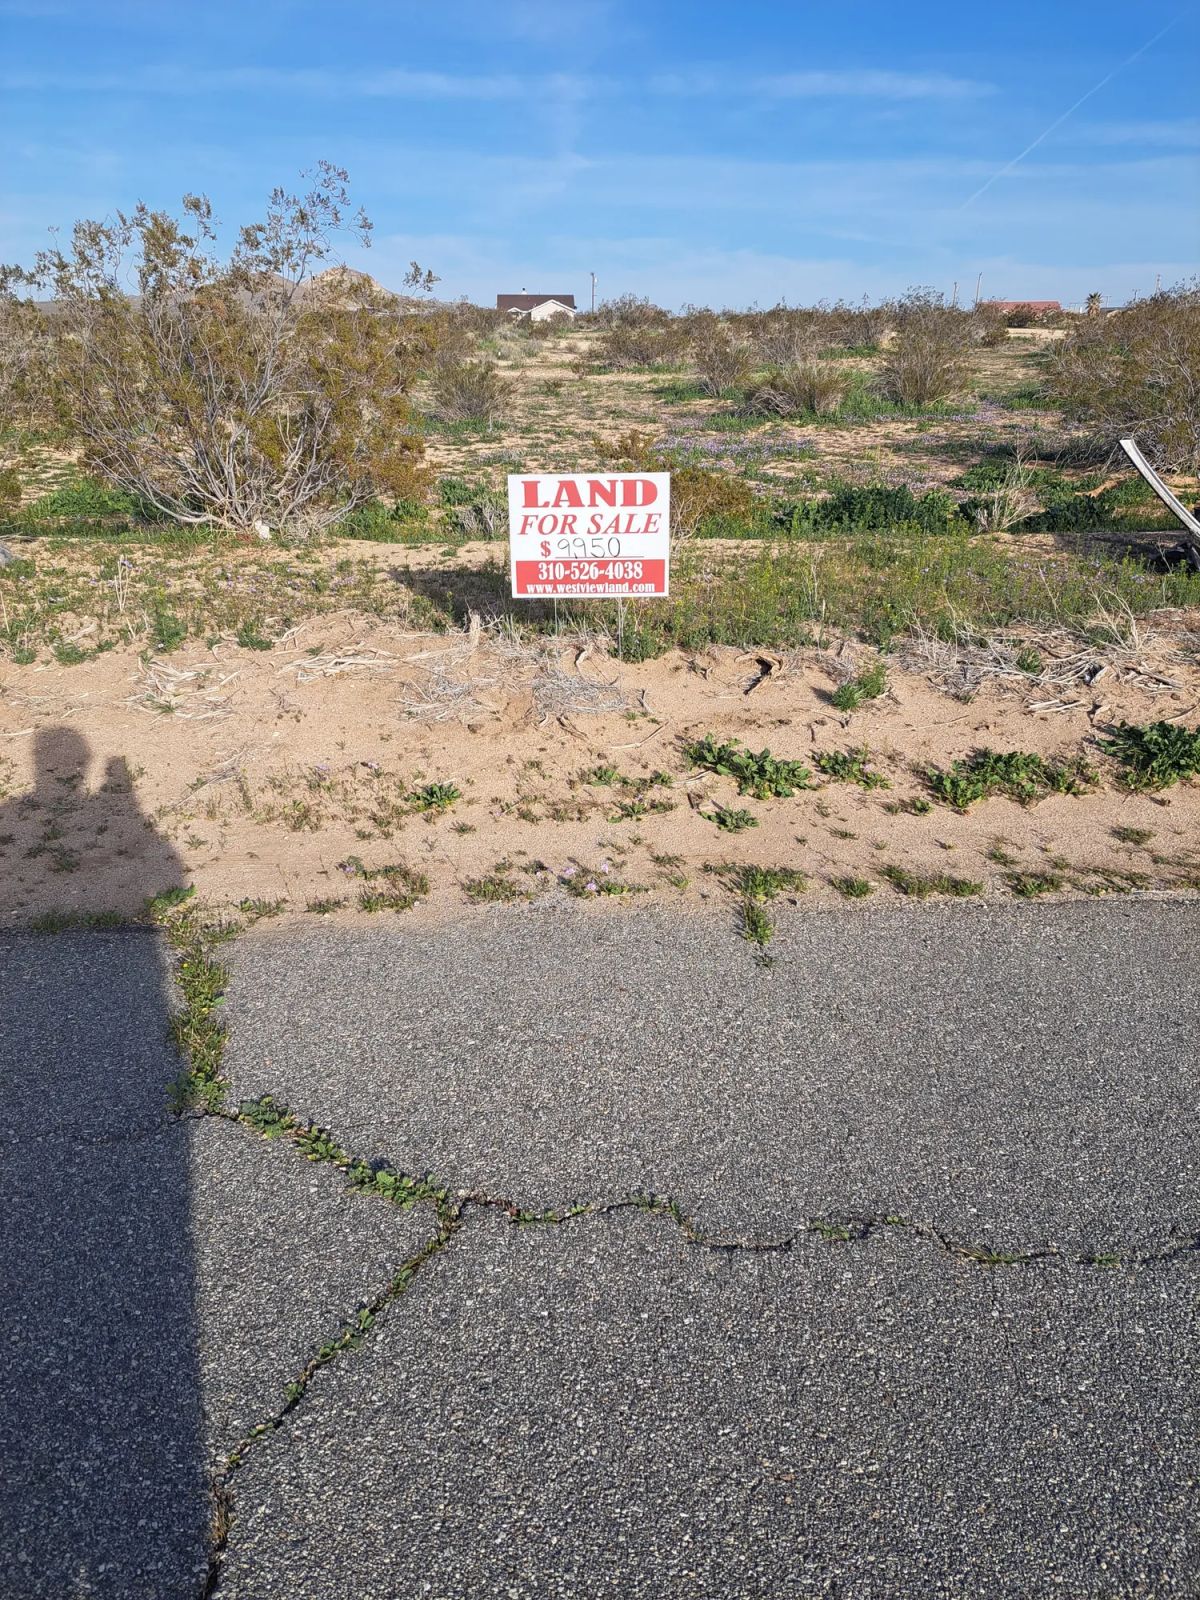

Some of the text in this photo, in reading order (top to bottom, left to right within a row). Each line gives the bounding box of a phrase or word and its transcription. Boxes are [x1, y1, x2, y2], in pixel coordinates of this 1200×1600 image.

[521, 479, 658, 508] LAND
[517, 513, 662, 535] FOR SALE
[540, 540, 551, 558] $
[538, 561, 643, 580] 310-526-4038
[526, 582, 655, 594] www.westviewland.com
